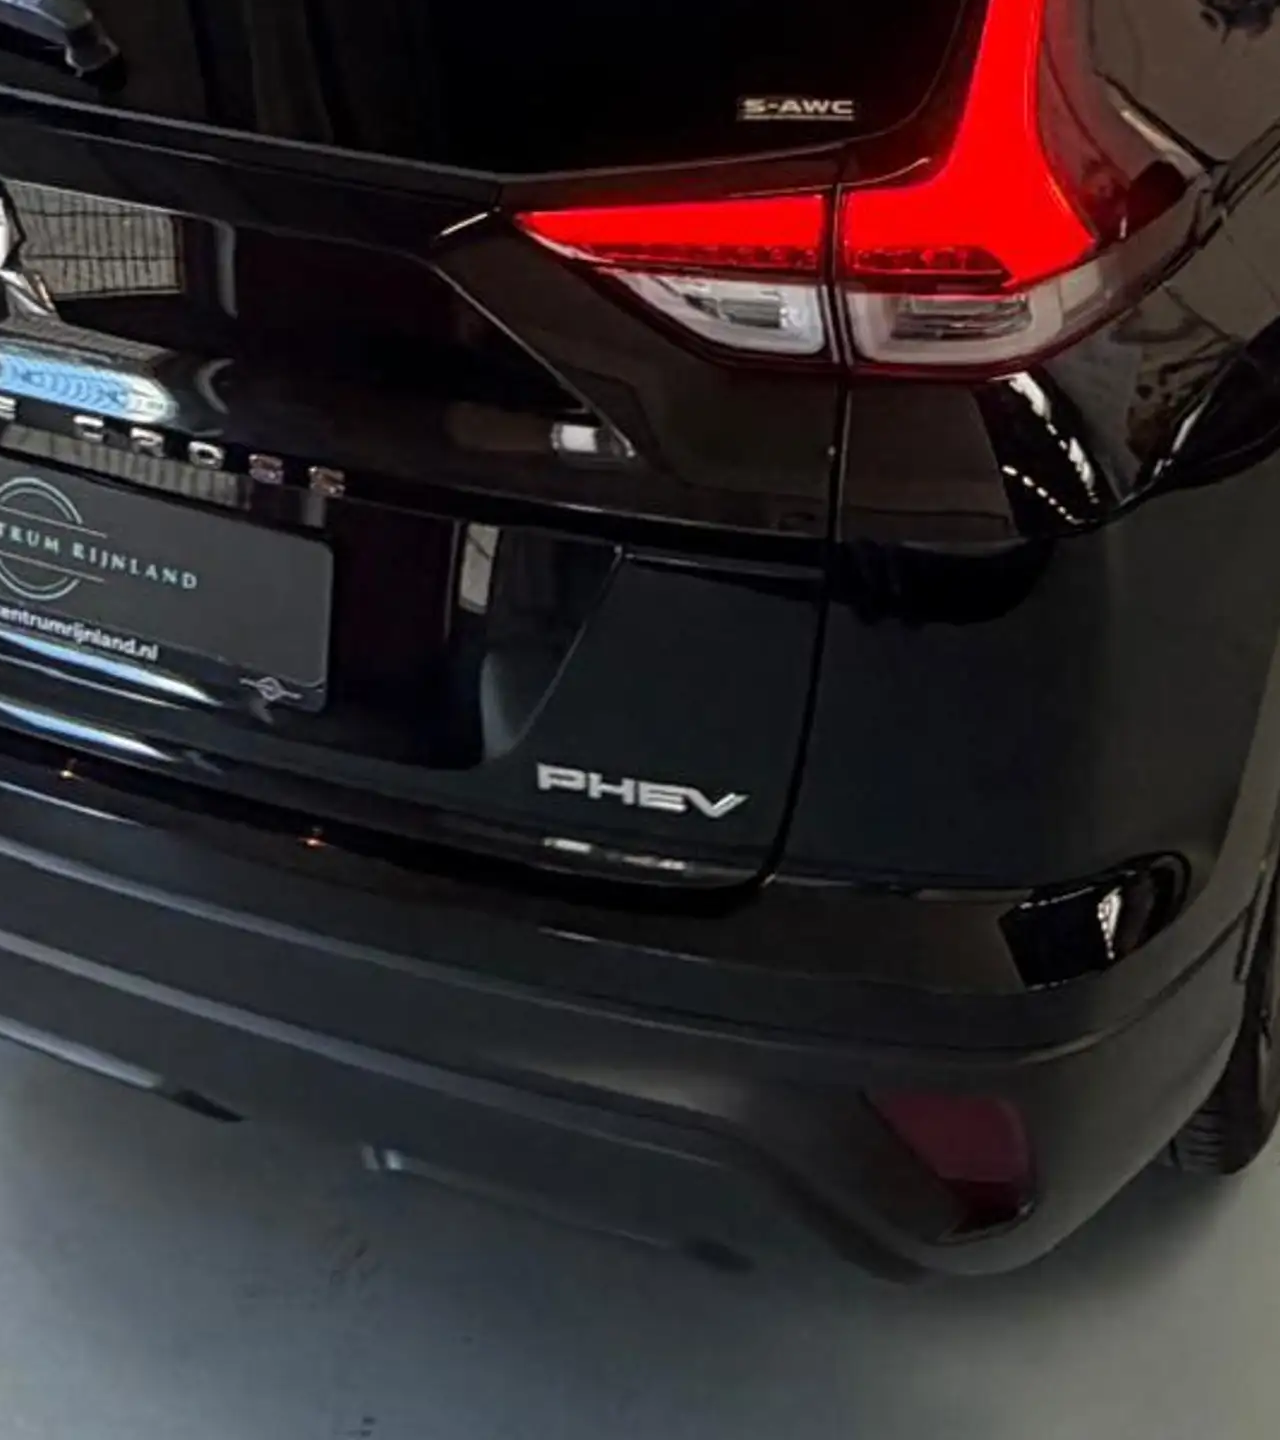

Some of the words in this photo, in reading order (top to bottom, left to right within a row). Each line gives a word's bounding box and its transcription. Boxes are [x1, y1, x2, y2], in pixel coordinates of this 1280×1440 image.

[742, 97, 854, 115] S-AWC
[71, 540, 199, 590] RIJNLAND
[536, 761, 750, 819] PHEV
